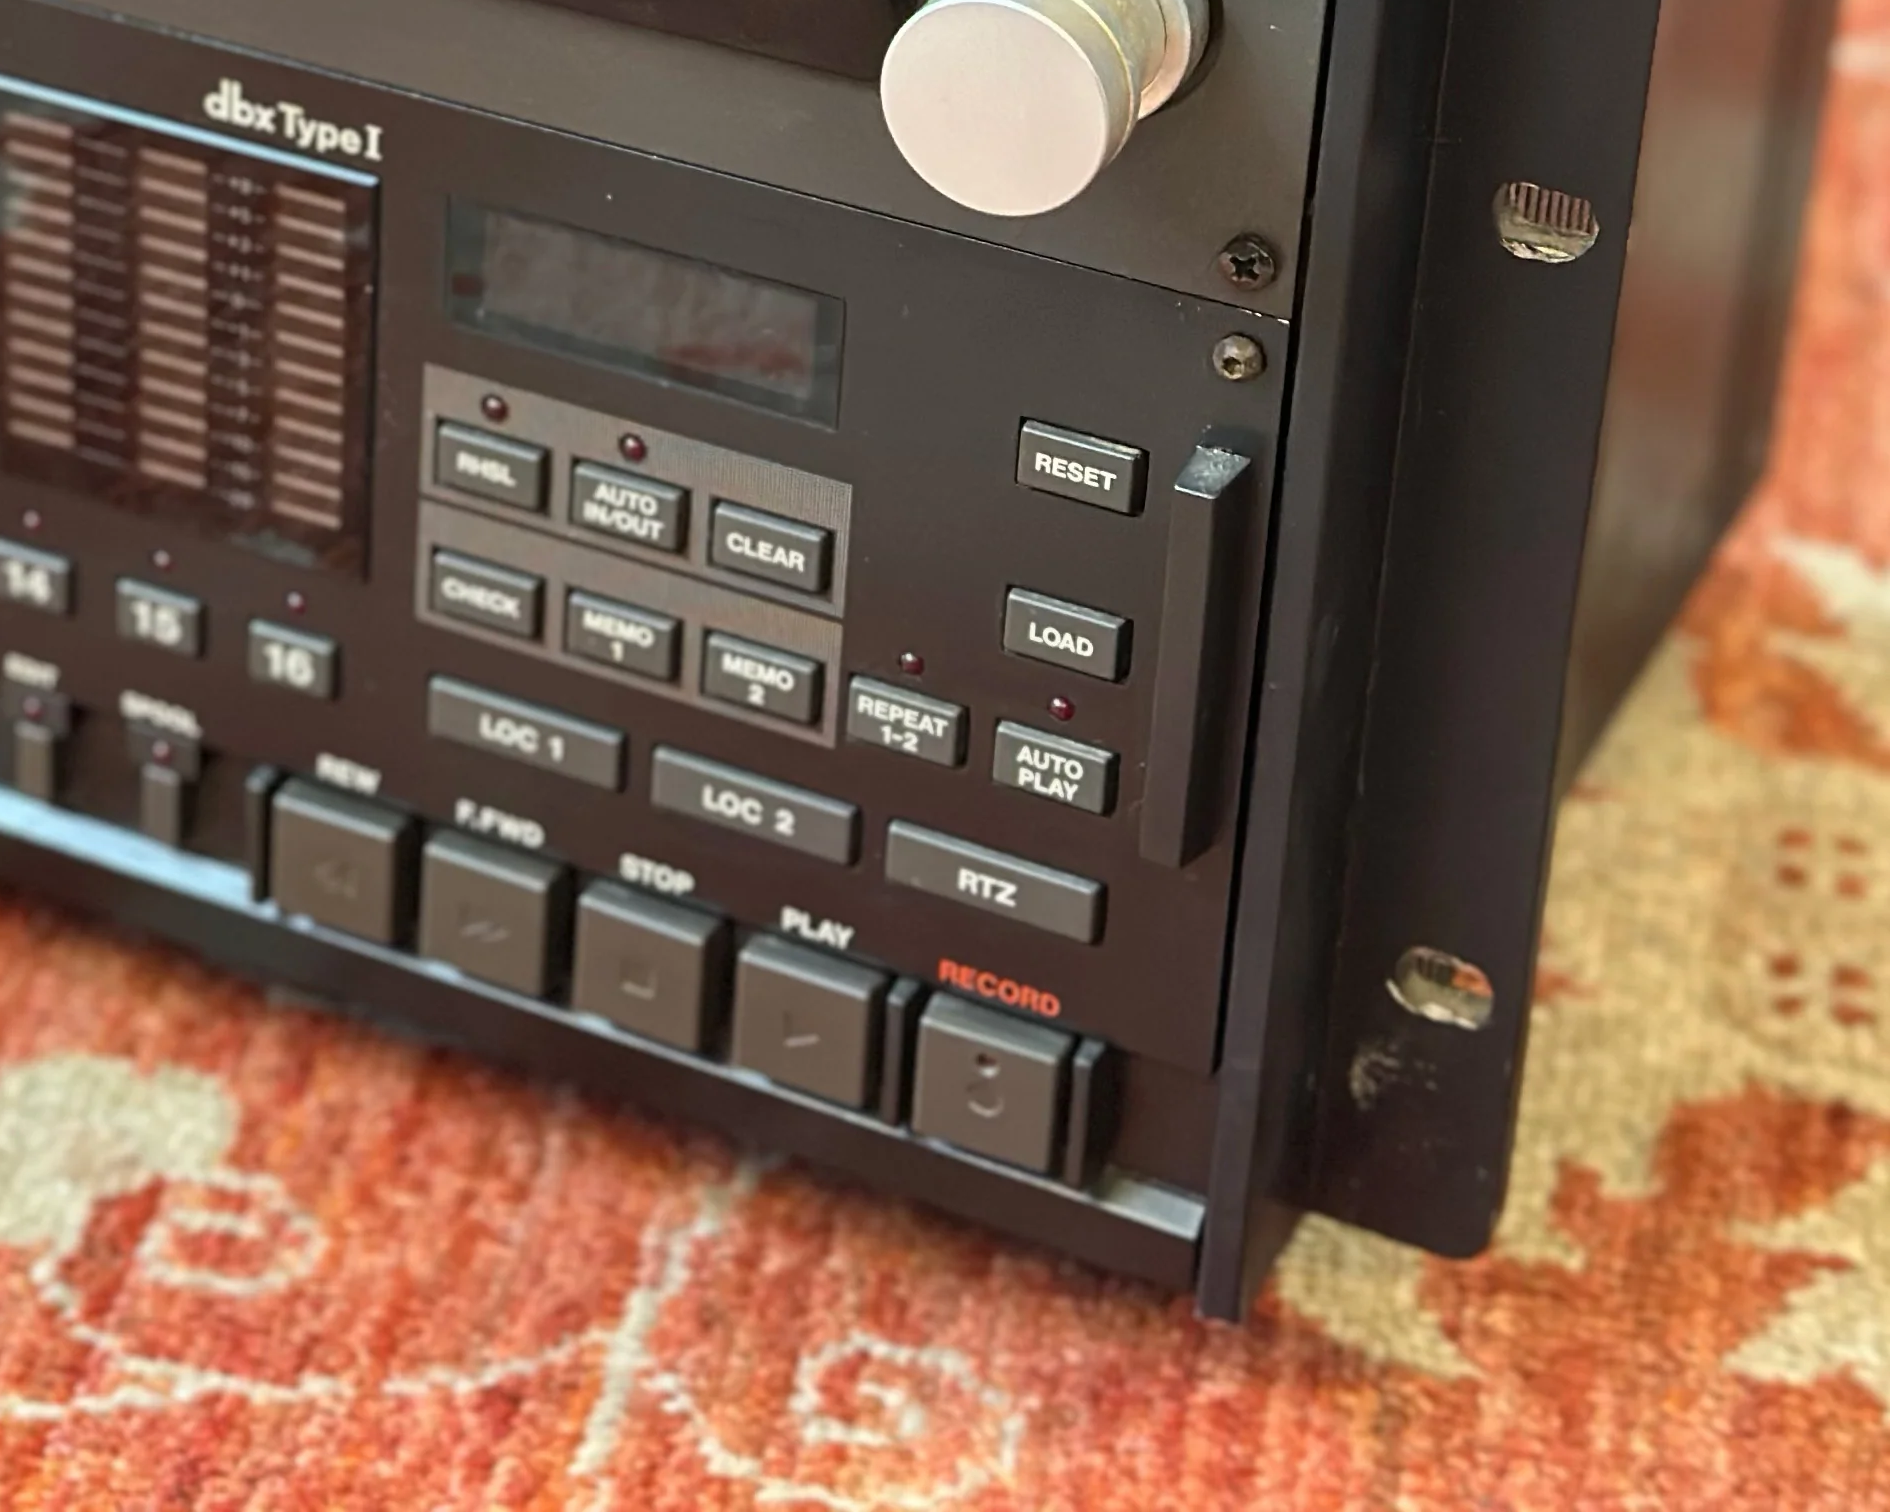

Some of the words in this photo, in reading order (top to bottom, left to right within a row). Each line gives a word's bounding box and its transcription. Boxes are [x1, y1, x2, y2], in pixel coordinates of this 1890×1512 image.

[203, 77, 276, 134] dbx
[277, 101, 362, 155] Type
[364, 124, 383, 162] I
[1035, 452, 1117, 491] RESET
[594, 484, 658, 515] AUTO
[583, 501, 664, 540] IN/OUT
[725, 532, 805, 572] CLEAR
[1, 559, 52, 606] 14
[441, 577, 520, 618] CHECK
[131, 599, 182, 646] 15
[582, 609, 655, 648] MEMO
[1028, 622, 1094, 658] LOAD
[263, 642, 314, 687] 16
[610, 642, 624, 661] 1
[722, 653, 795, 691] MEMO
[747, 684, 765, 705] 2
[479, 713, 540, 753] LOC
[548, 736, 564, 761] 1
[857, 694, 949, 739] REPEAT
[880, 724, 918, 753] 1-2
[315, 752, 380, 794] REW
[1016, 745, 1083, 780] AUTO
[1018, 766, 1079, 802] PLAY
[455, 798, 545, 849] F.FWD
[702, 785, 764, 826] LOC
[774, 809, 795, 836] 2
[619, 852, 695, 895] STOP
[957, 867, 1017, 908] RTZ
[780, 906, 854, 950] PLAY
[938, 958, 1061, 1019] RECORD
